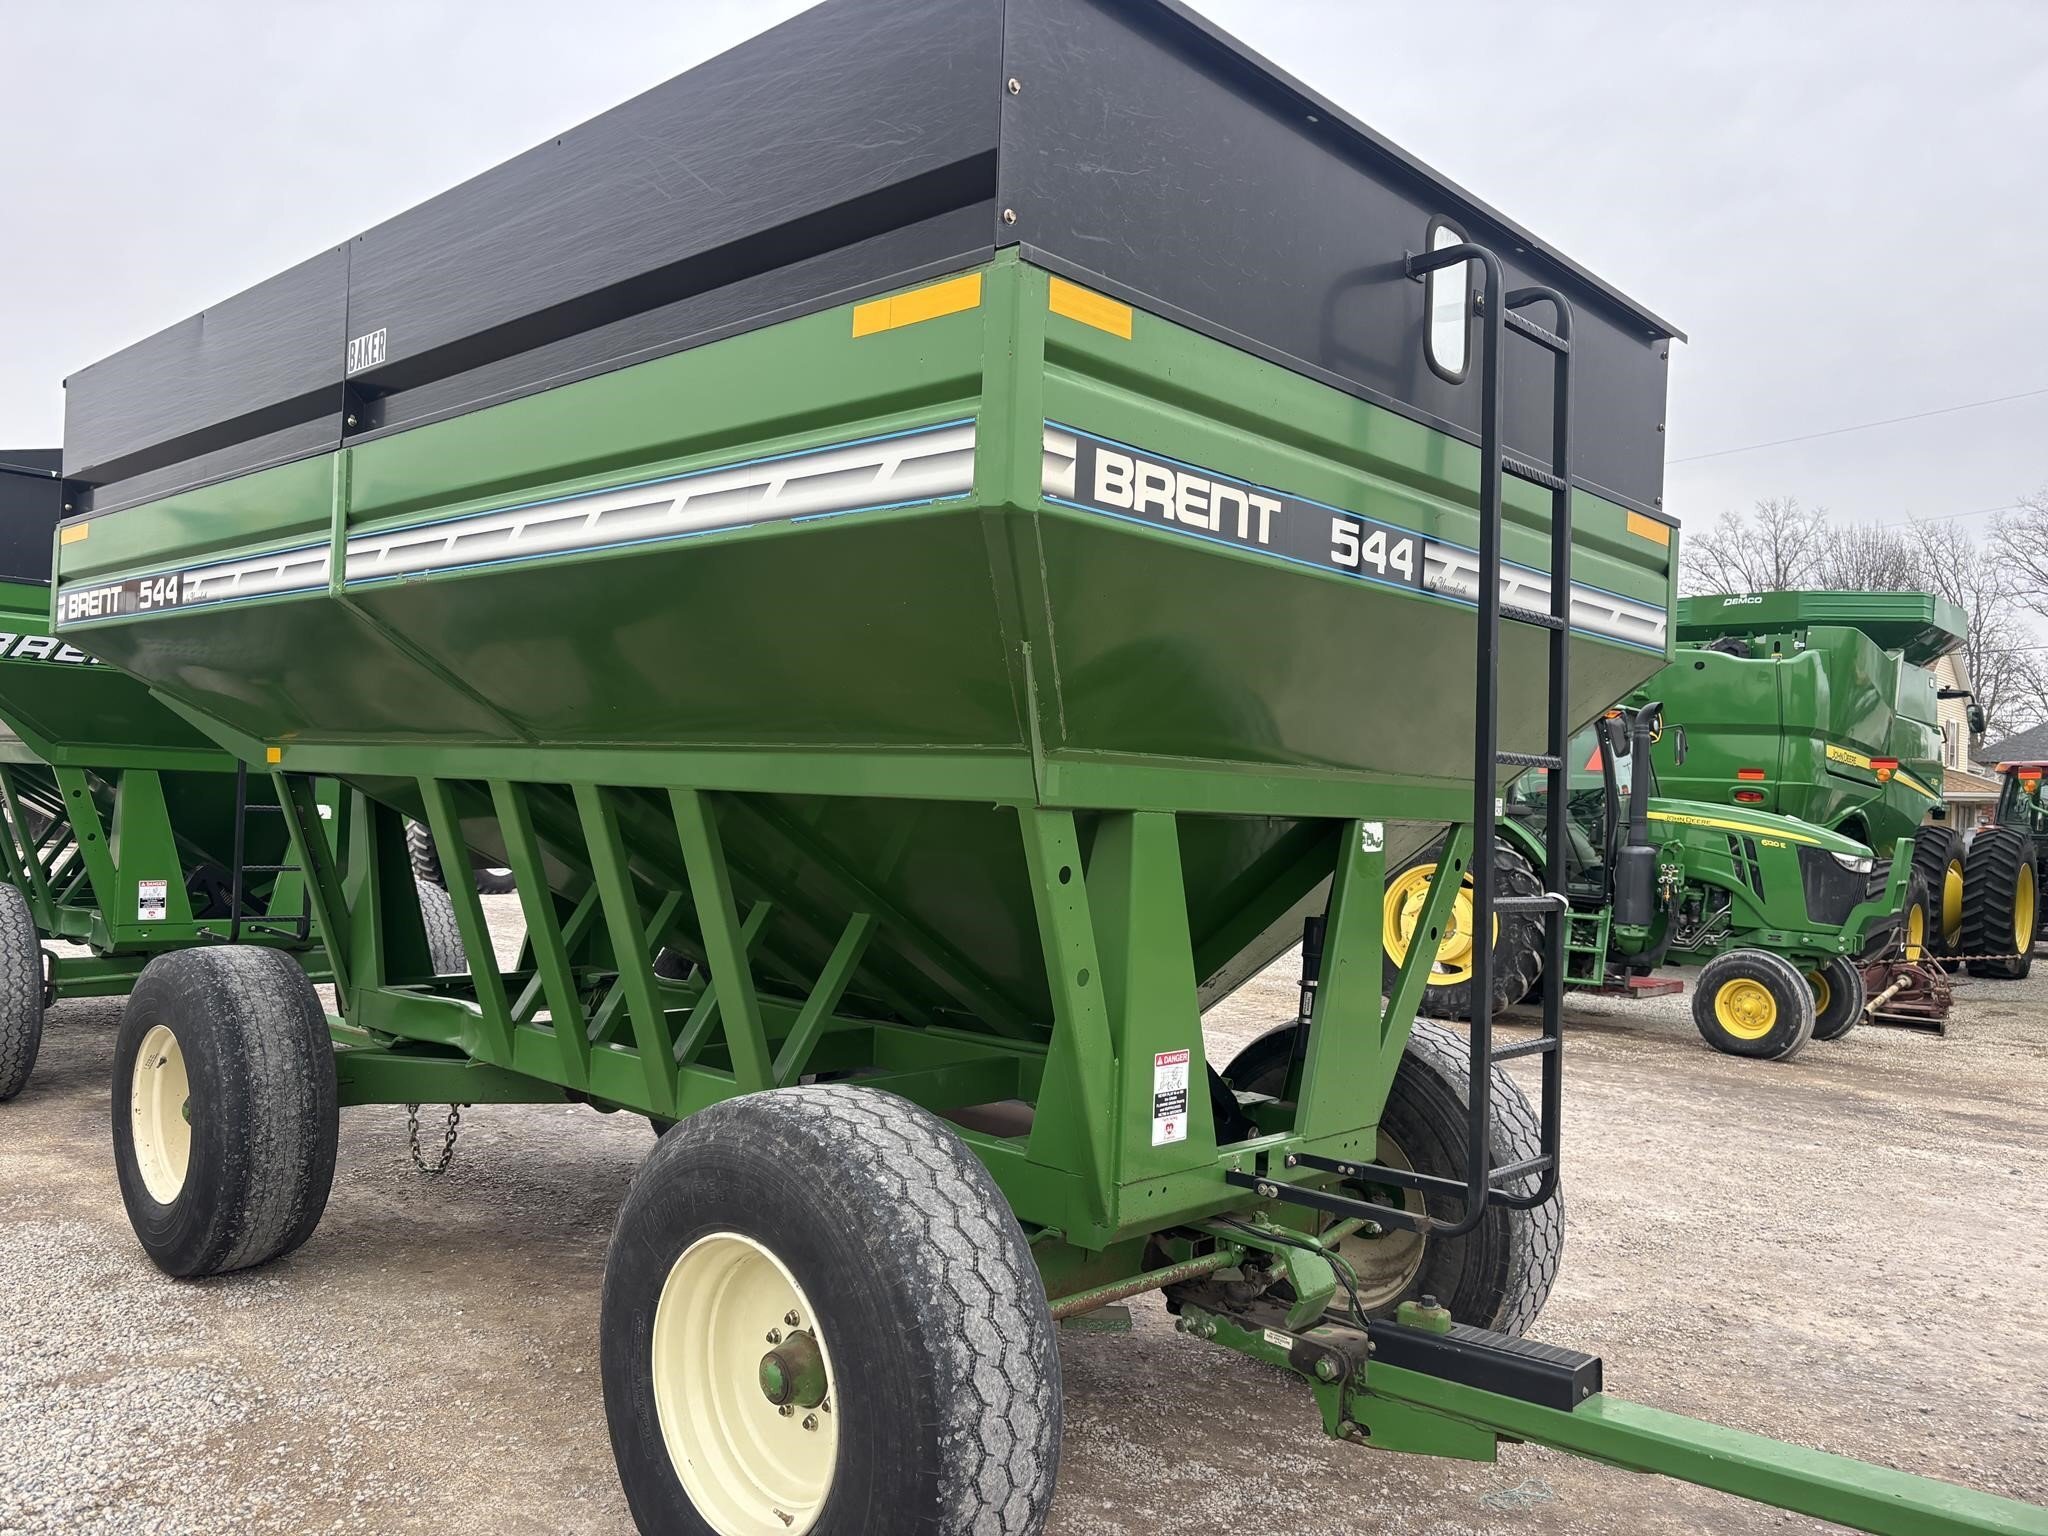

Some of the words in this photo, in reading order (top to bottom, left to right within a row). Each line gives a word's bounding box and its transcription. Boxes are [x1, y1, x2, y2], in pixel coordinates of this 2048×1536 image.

[349, 330, 385, 372] BAKER
[1094, 447, 1282, 544] BRENT
[1331, 517, 1413, 581] 544
[68, 585, 123, 620] BRENT
[139, 575, 178, 609] 544
[1723, 596, 1763, 607] DEMCO
[1664, 815, 1685, 823] JOHN
[1685, 816, 1711, 825] DEERE
[1163, 1052, 1188, 1065] DANGER
